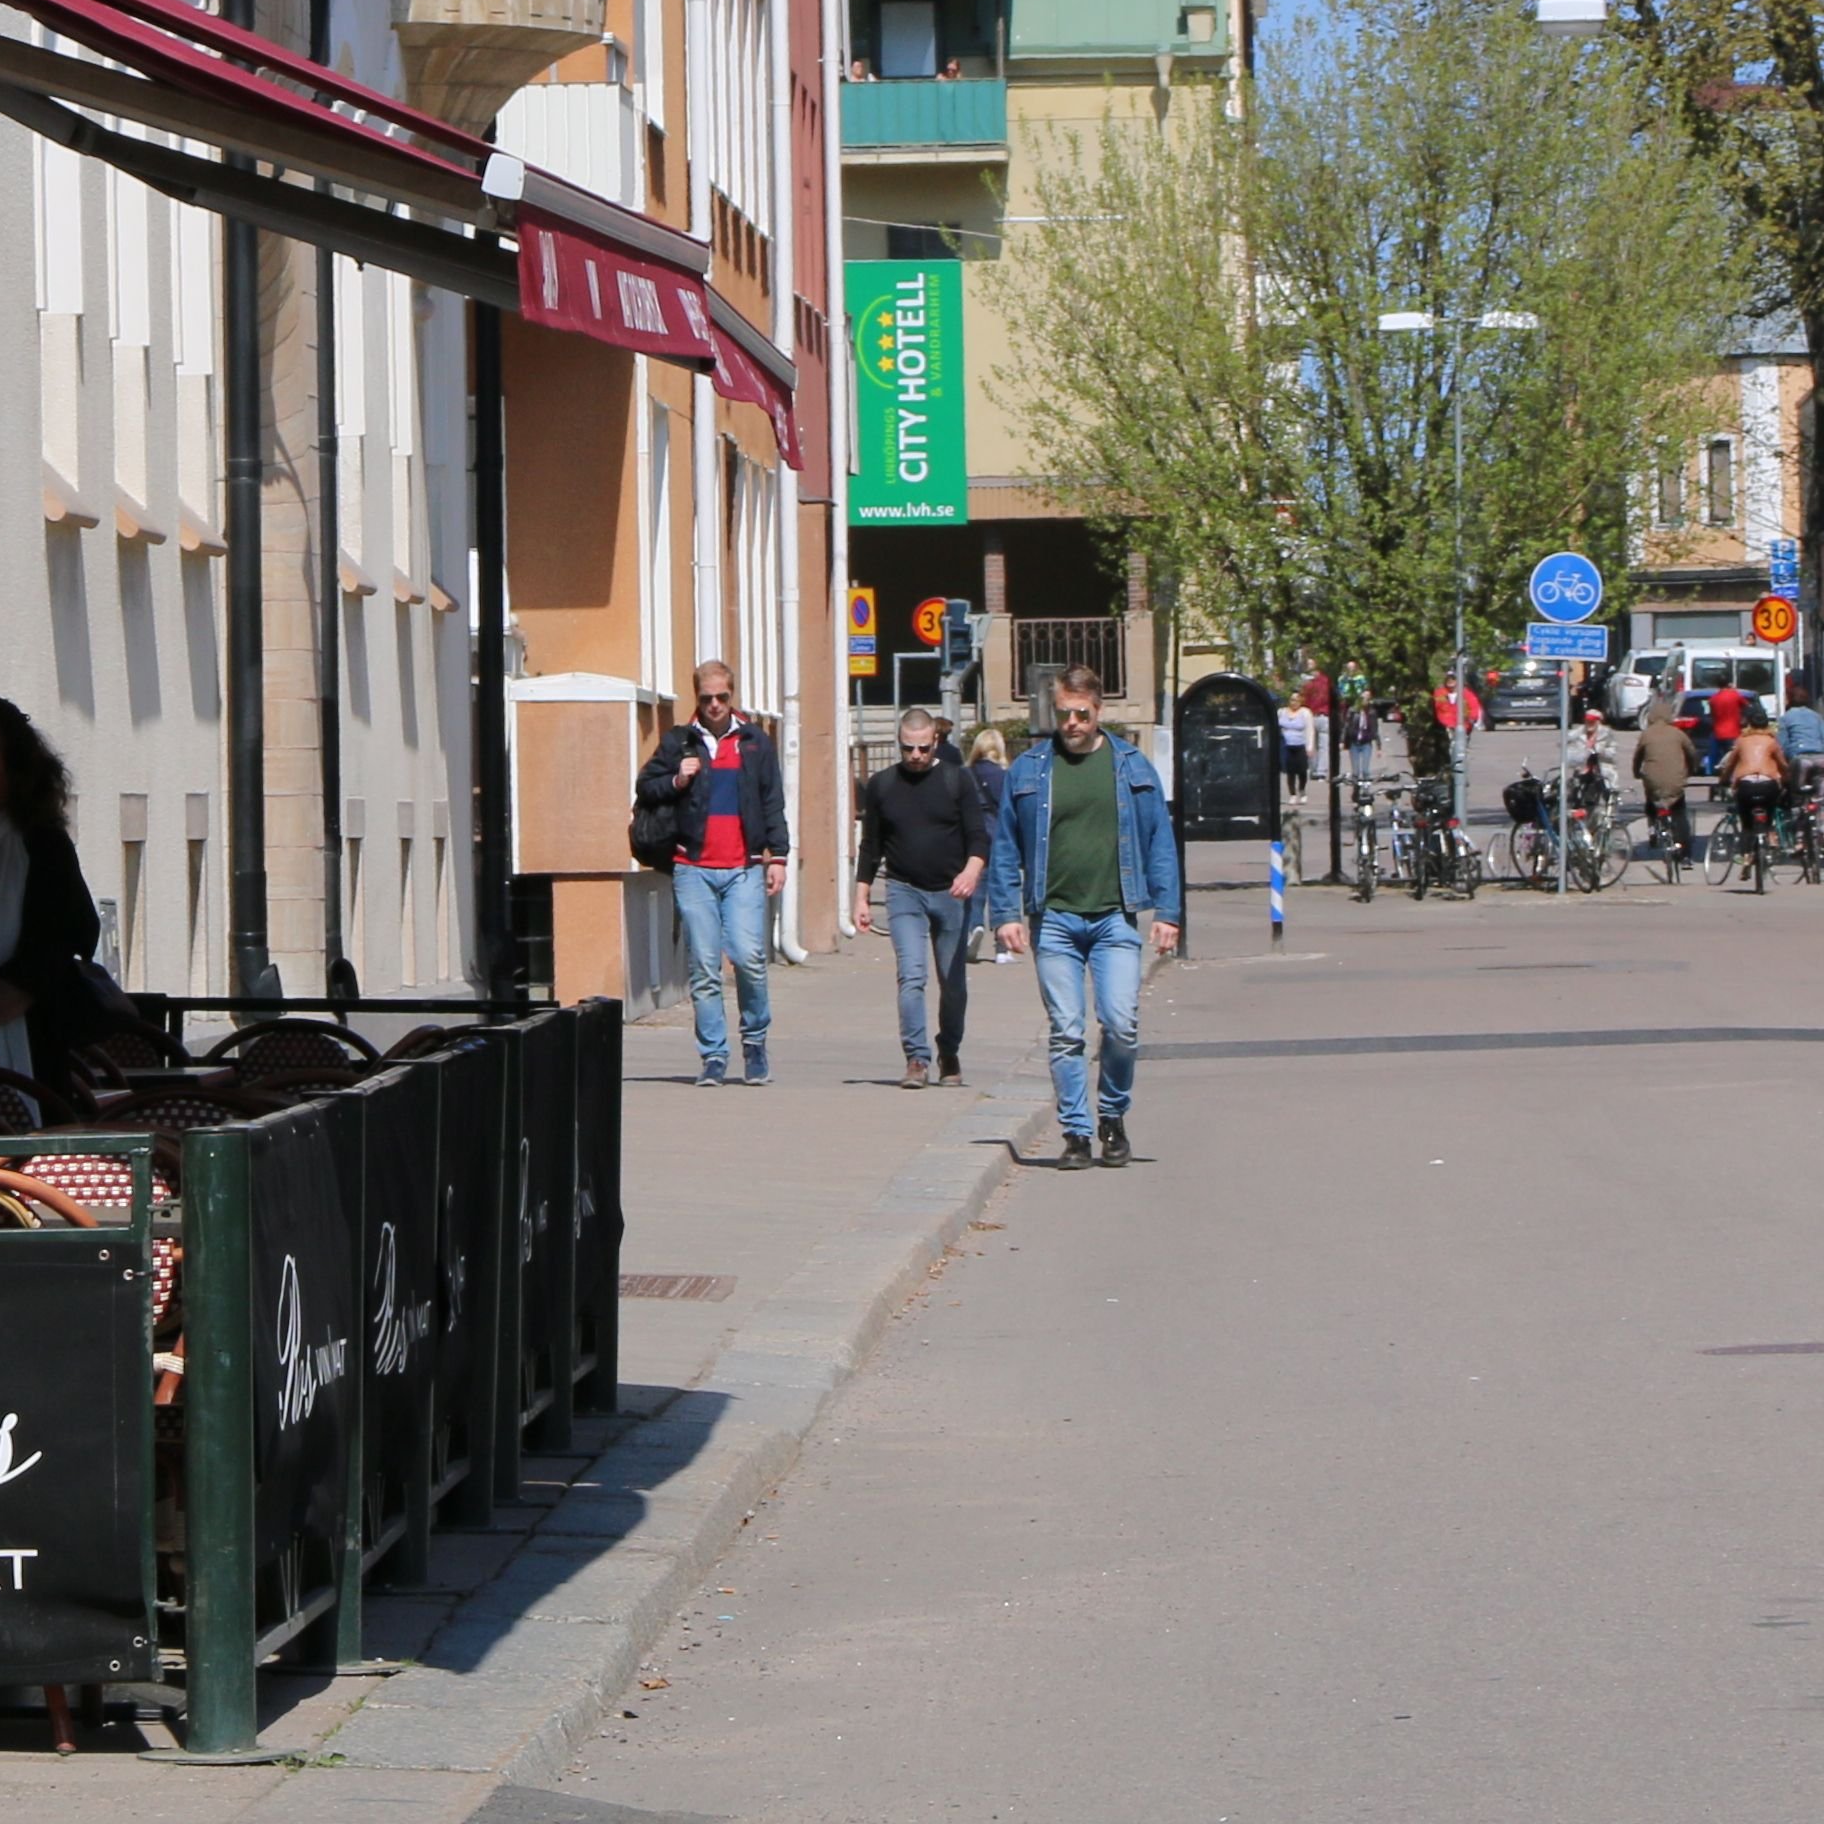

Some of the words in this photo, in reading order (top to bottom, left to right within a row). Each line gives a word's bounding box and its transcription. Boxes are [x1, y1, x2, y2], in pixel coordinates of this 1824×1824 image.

[896, 272, 927, 402] HOTELL
[929, 274, 943, 380] VANDRARHEM
[898, 408, 928, 483] CITY
[859, 502, 955, 519] www.lvh.se
[1759, 608, 1789, 631] 30
